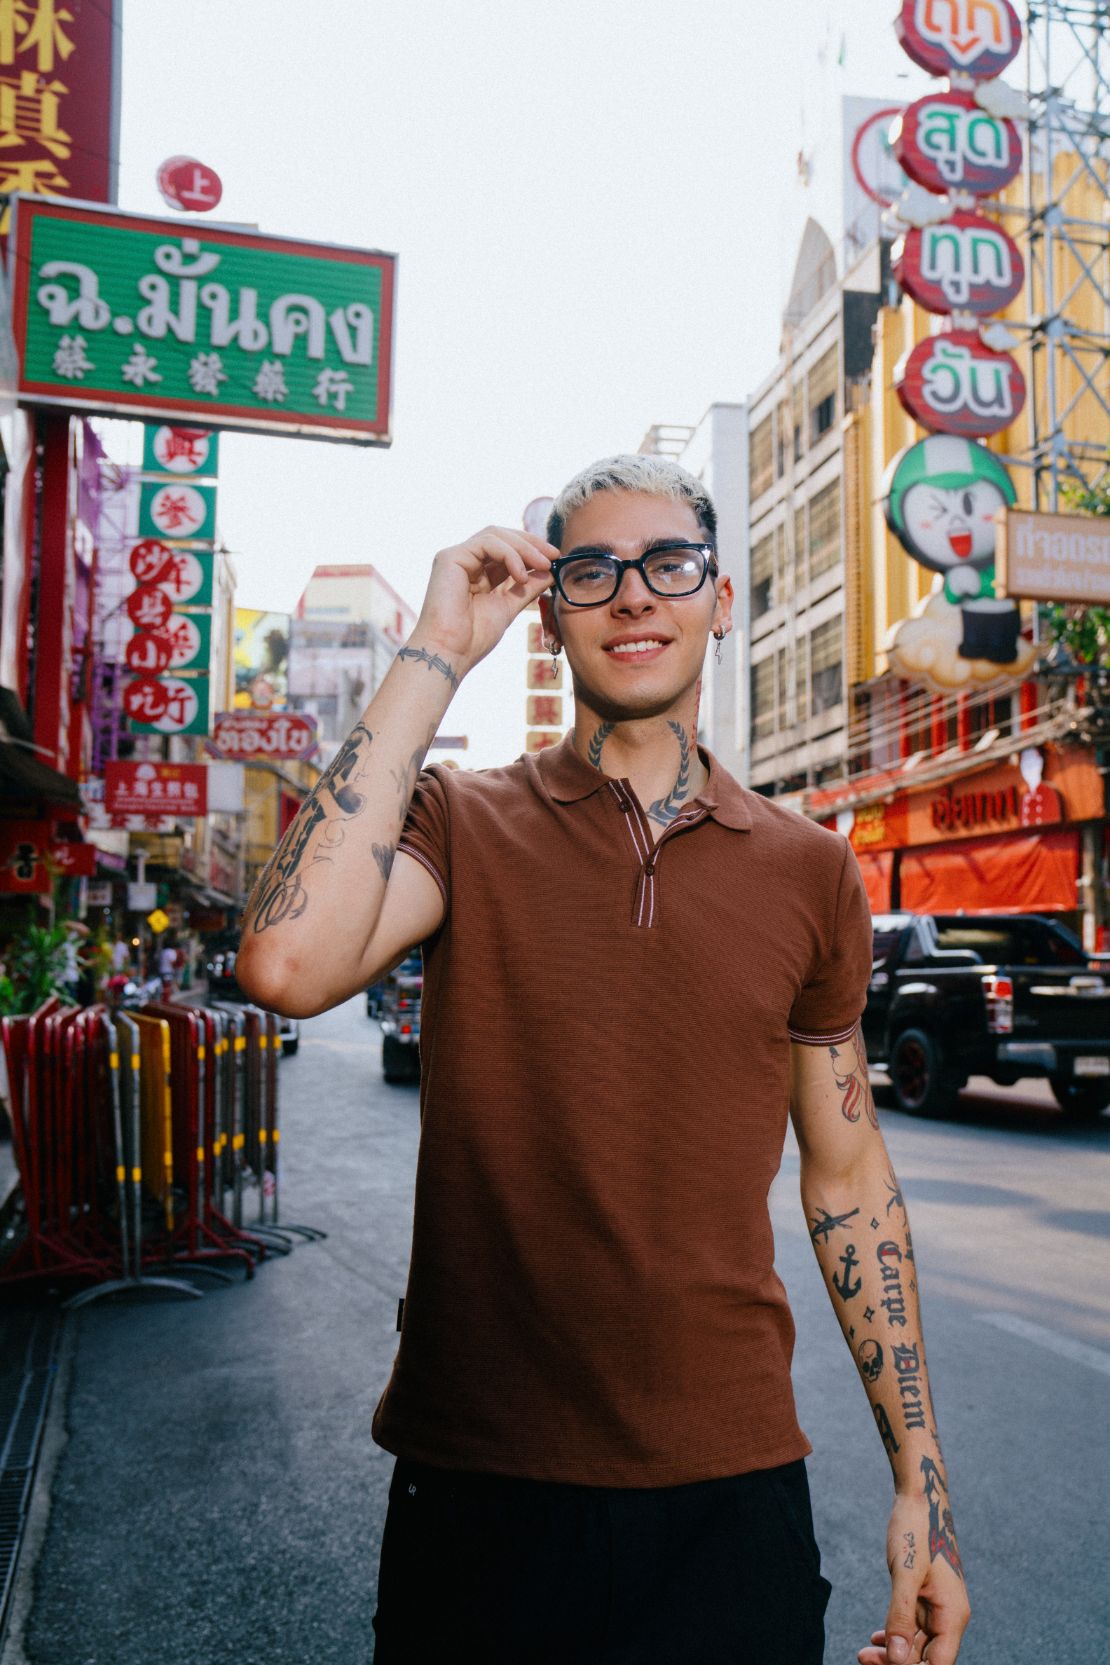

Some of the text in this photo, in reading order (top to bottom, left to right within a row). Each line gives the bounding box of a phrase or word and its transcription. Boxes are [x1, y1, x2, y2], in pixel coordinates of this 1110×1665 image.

[921, 107, 1005, 177] สุด
[926, 229, 1007, 299] ทุก
[37, 238, 374, 366] ฉ.มั่นคง
[926, 343, 1008, 411] วัน
[876, 1240, 926, 1430] Carpe Diem
